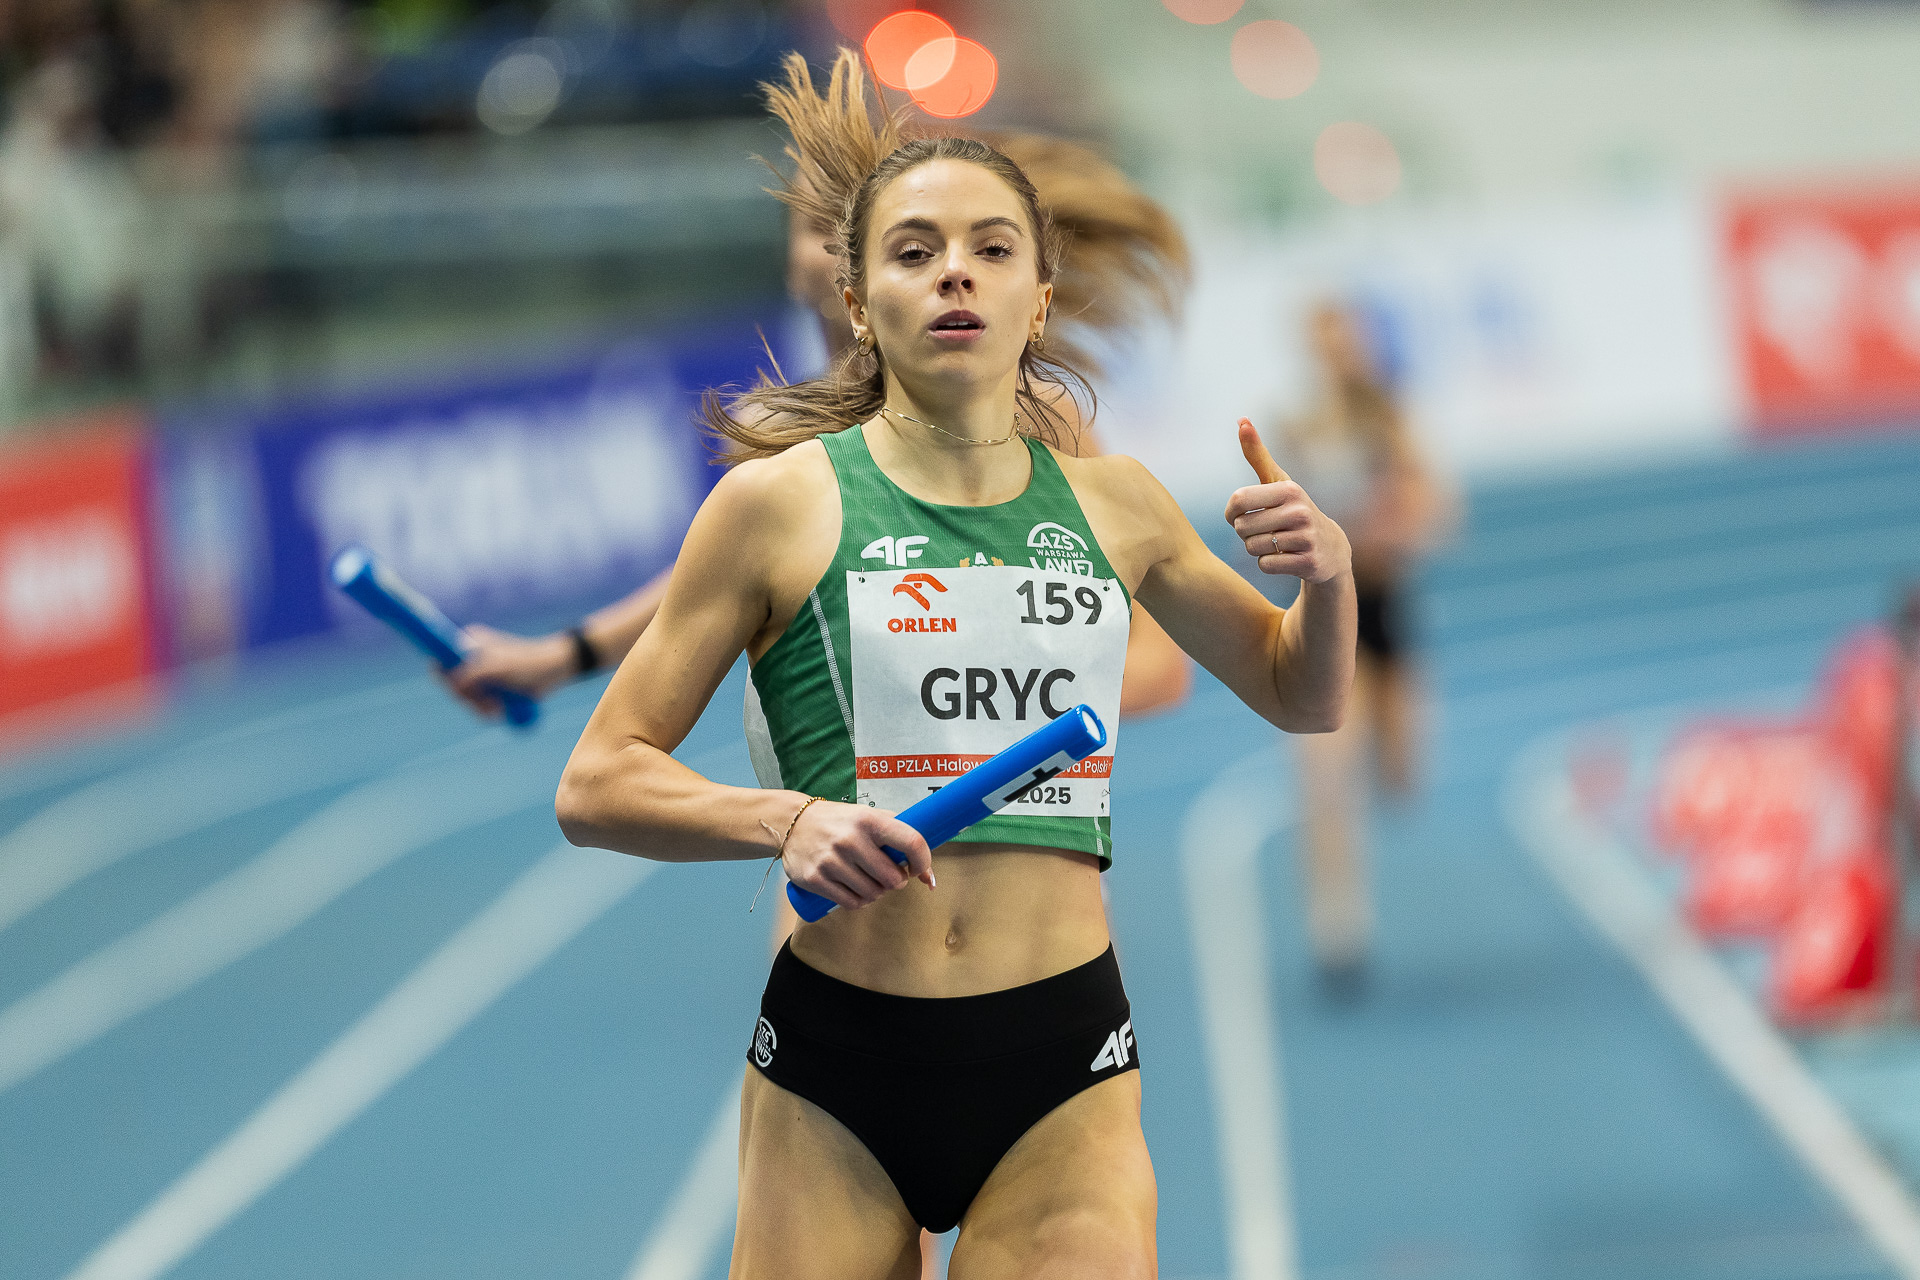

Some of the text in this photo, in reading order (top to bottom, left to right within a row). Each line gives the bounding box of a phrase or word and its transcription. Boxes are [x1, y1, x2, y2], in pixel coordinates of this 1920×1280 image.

[860, 535, 930, 567] 4F
[1040, 532, 1075, 551] AZS
[1036, 548, 1086, 558] WARSZAWA
[1015, 579, 1103, 625] 159
[887, 617, 957, 633] ORLEN
[920, 667, 1076, 721] GRYC
[868, 760, 893, 774] 69.
[896, 759, 932, 773] PZLA
[936, 757, 984, 772] Halow
